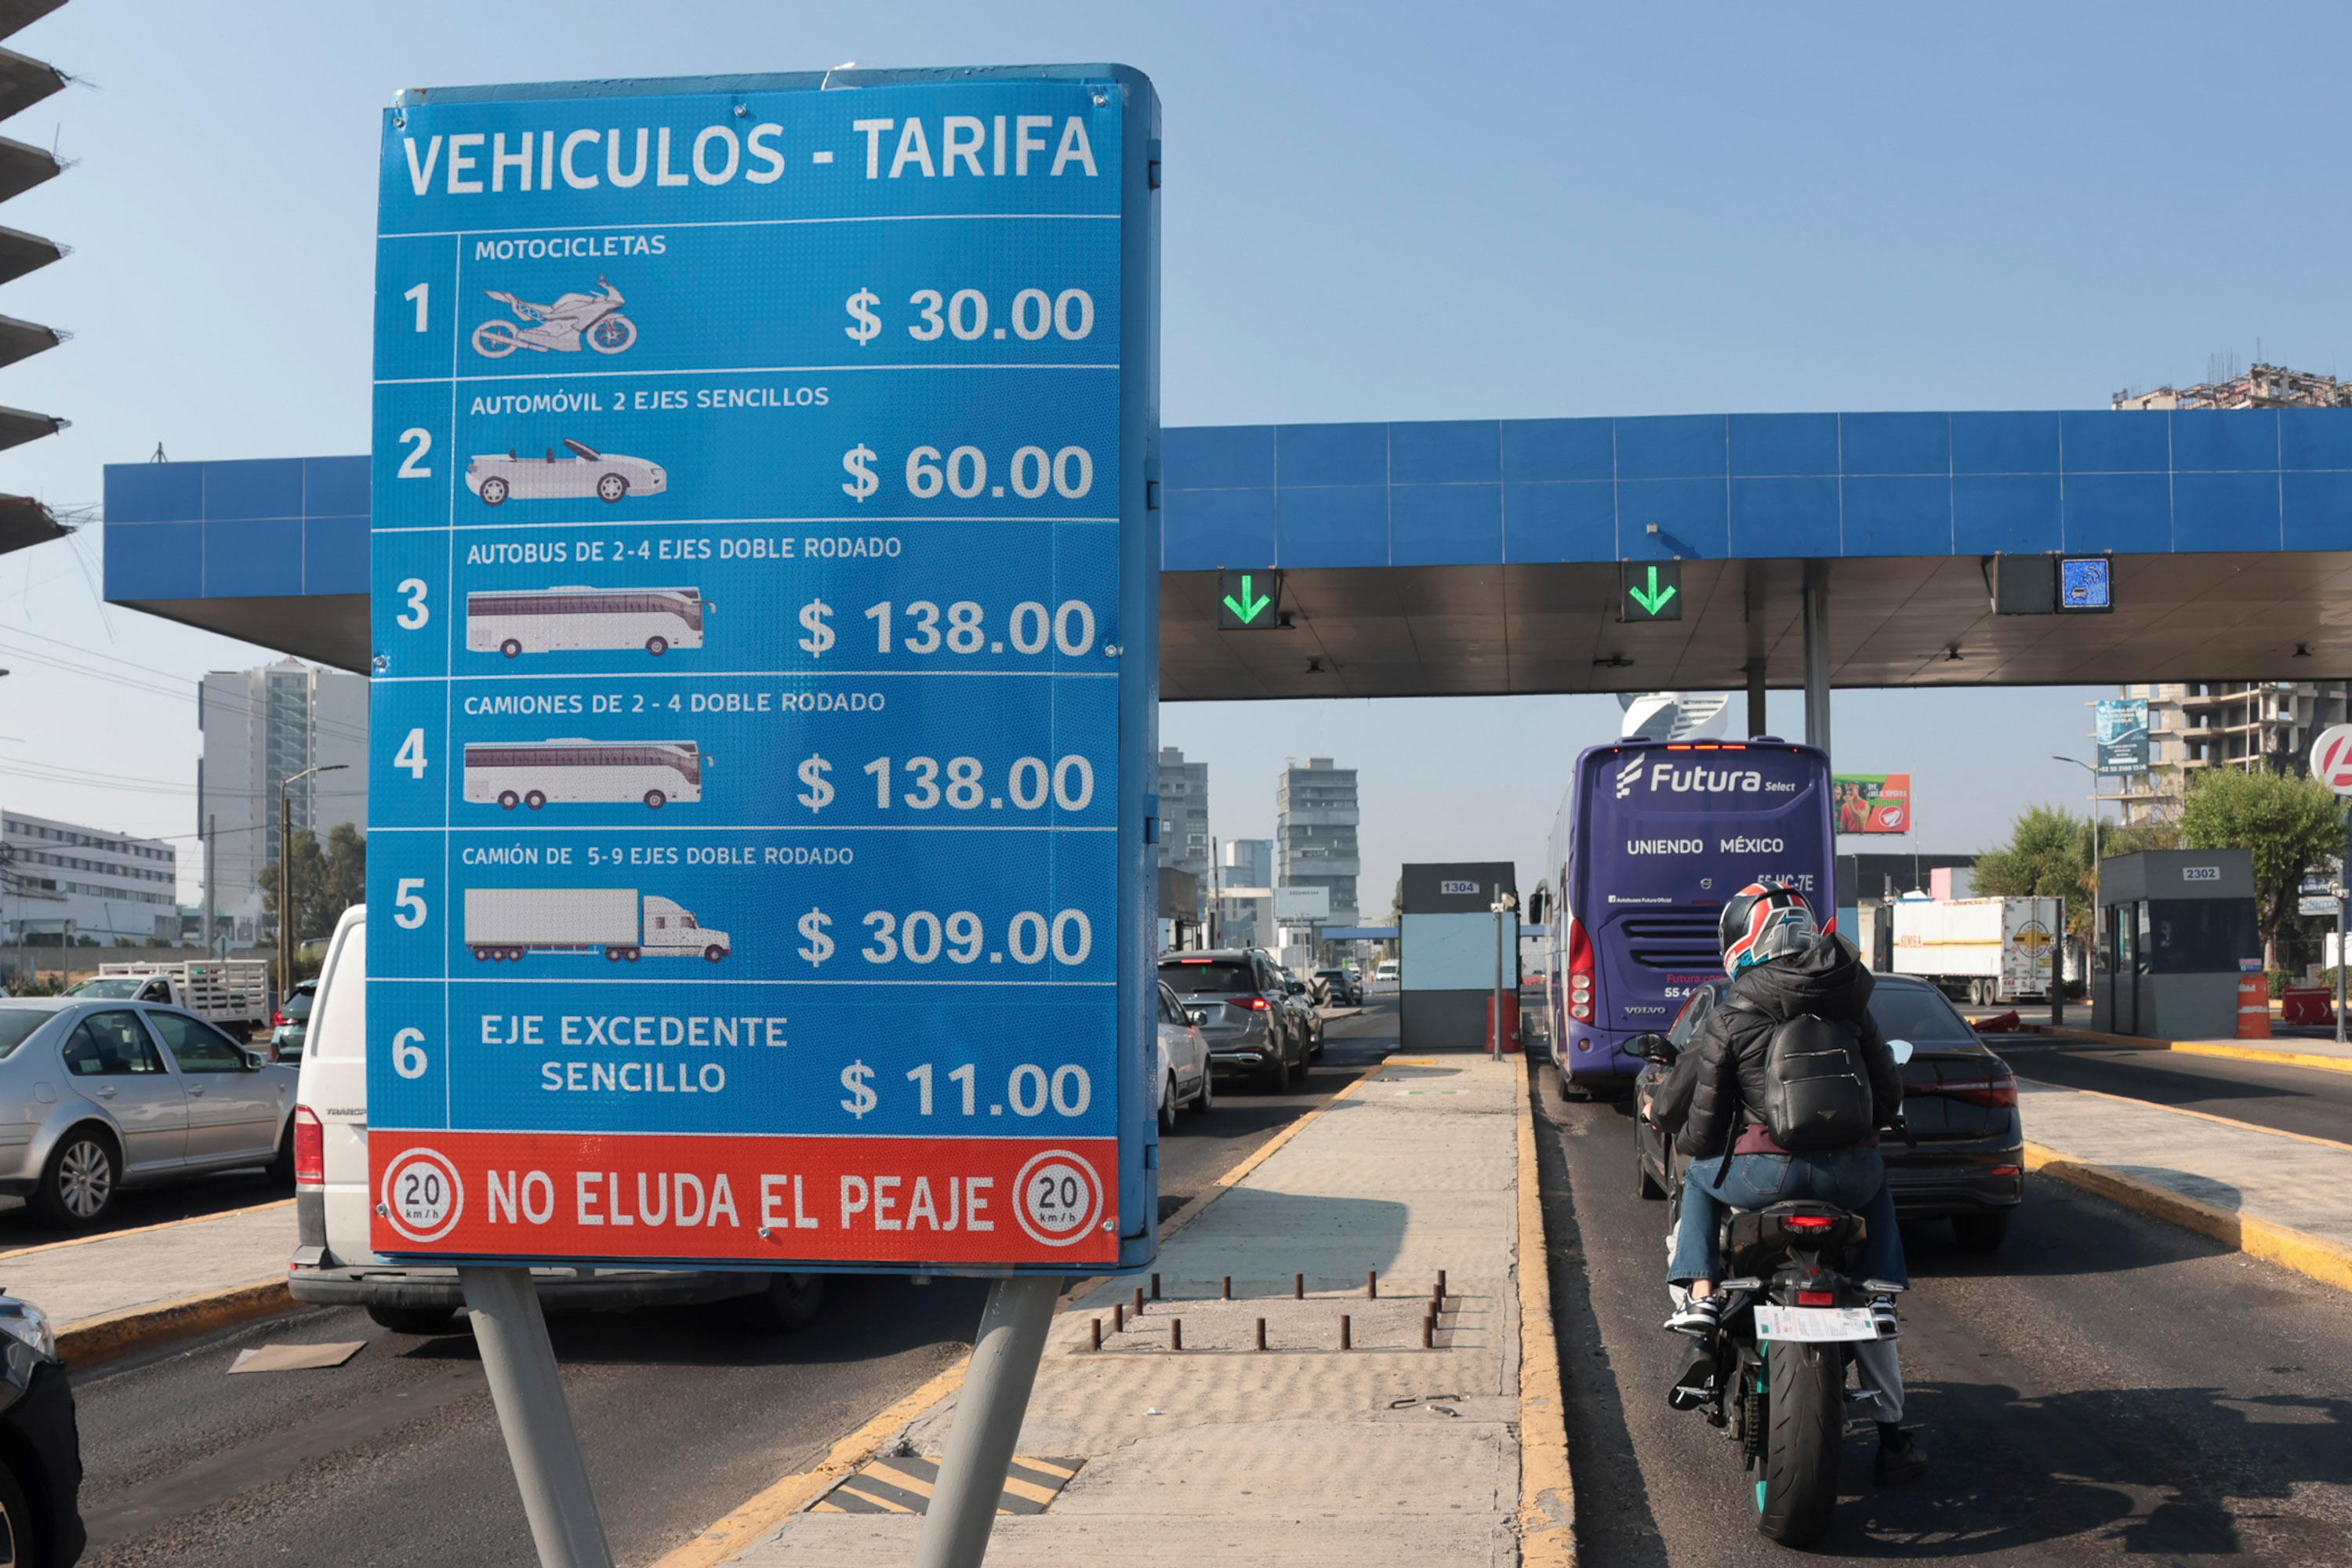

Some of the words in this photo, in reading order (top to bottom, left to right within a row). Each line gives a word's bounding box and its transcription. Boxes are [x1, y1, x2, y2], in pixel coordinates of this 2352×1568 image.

[403, 122, 786, 196] VEHICULOS
[813, 151, 833, 163] -
[854, 116, 1098, 179] TARIFA
[474, 234, 667, 260] MOTOCICLETAS
[405, 283, 428, 332] 1
[846, 288, 881, 346] $
[909, 289, 1094, 340] 30.00
[470, 390, 603, 415] AUTOMÓVIL
[614, 393, 625, 409] 2
[636, 391, 688, 408] EJES
[698, 387, 829, 408] SENCILLOS
[398, 428, 431, 477] 2
[843, 444, 879, 502] $
[906, 446, 1092, 498] 60.00
[468, 543, 567, 564] AUTOBUS
[577, 542, 603, 561] DE
[614, 541, 649, 560] 2-4
[660, 539, 710, 559] EJES
[720, 539, 794, 558] DOBLE
[805, 538, 900, 557] RODADO
[397, 579, 429, 630] 3
[800, 599, 835, 658] $
[866, 601, 1094, 655] 138.00
[464, 695, 583, 715] CAMIONES
[593, 695, 622, 712] DE
[633, 695, 643, 712] 2
[669, 695, 681, 711] 4
[691, 694, 770, 712] DOBLE
[783, 694, 884, 710] RODADO
[394, 728, 427, 778] 4
[798, 753, 834, 813] $
[865, 755, 1093, 811] 138.00
[1650, 764, 1762, 793] Futura
[1765, 781, 1795, 793] Select
[463, 844, 539, 865] CAMIÓN
[547, 848, 571, 863] DE
[590, 848, 622, 865] 5-9
[632, 848, 677, 863] EJES
[688, 848, 755, 863] DOBLE
[764, 848, 854, 864] RODADO
[1627, 839, 1704, 855] UNIENDO
[1720, 836, 1784, 854] MÉXICO
[1443, 882, 1475, 893] 1304
[1757, 874, 1814, 891] 55C-7E
[2187, 869, 2216, 879] 2302
[394, 879, 426, 928] 5
[799, 908, 833, 967] $
[862, 909, 1091, 964] 309.00
[1624, 1006, 1666, 1015] VOLVO
[482, 1016, 543, 1044] EJE
[562, 1017, 786, 1046] EXCEDENTE
[393, 1028, 426, 1079] 6
[543, 1062, 724, 1091] SENCILLO
[841, 1060, 877, 1119] $
[908, 1064, 1090, 1116] 11.00
[405, 1173, 441, 1206] 20
[488, 1171, 554, 1224] NO
[577, 1172, 739, 1226] ELUDA
[758, 1174, 818, 1229] EL
[840, 1176, 993, 1231] PEAJE
[1039, 1176, 1078, 1209] 20
